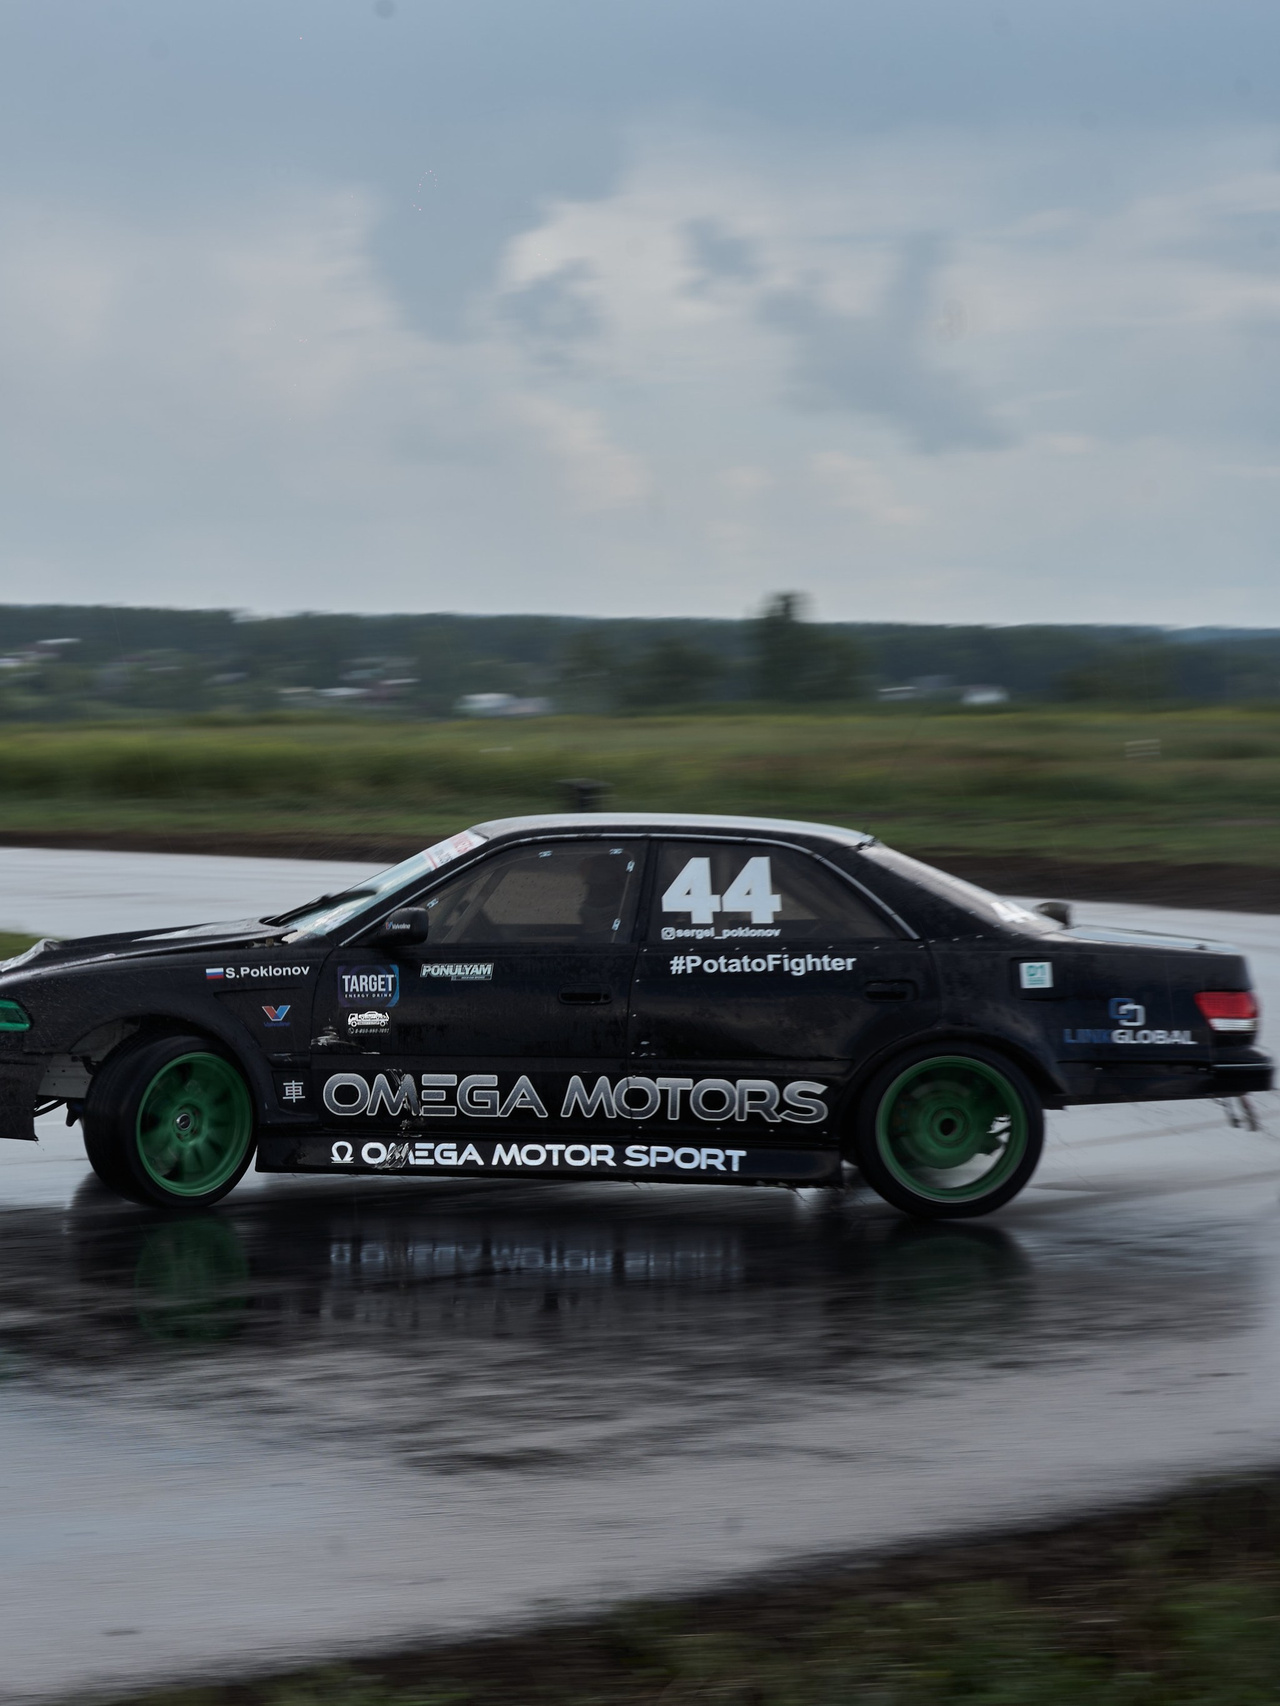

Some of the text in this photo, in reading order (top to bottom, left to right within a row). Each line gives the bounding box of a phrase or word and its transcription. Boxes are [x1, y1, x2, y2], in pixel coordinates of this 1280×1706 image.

[662, 857, 782, 924] 44
[225, 966, 310, 978] S.Poklonov
[422, 964, 492, 976] PONULYAM
[670, 954, 856, 976] #PotatoFighter
[342, 974, 395, 992] TARGET
[282, 1080, 306, 1103] 車
[323, 1073, 829, 1124] OMEGA MOTORS
[361, 1142, 484, 1167] OMEGA
[491, 1143, 617, 1167] MOTOR
[623, 1145, 747, 1171] SPORT
